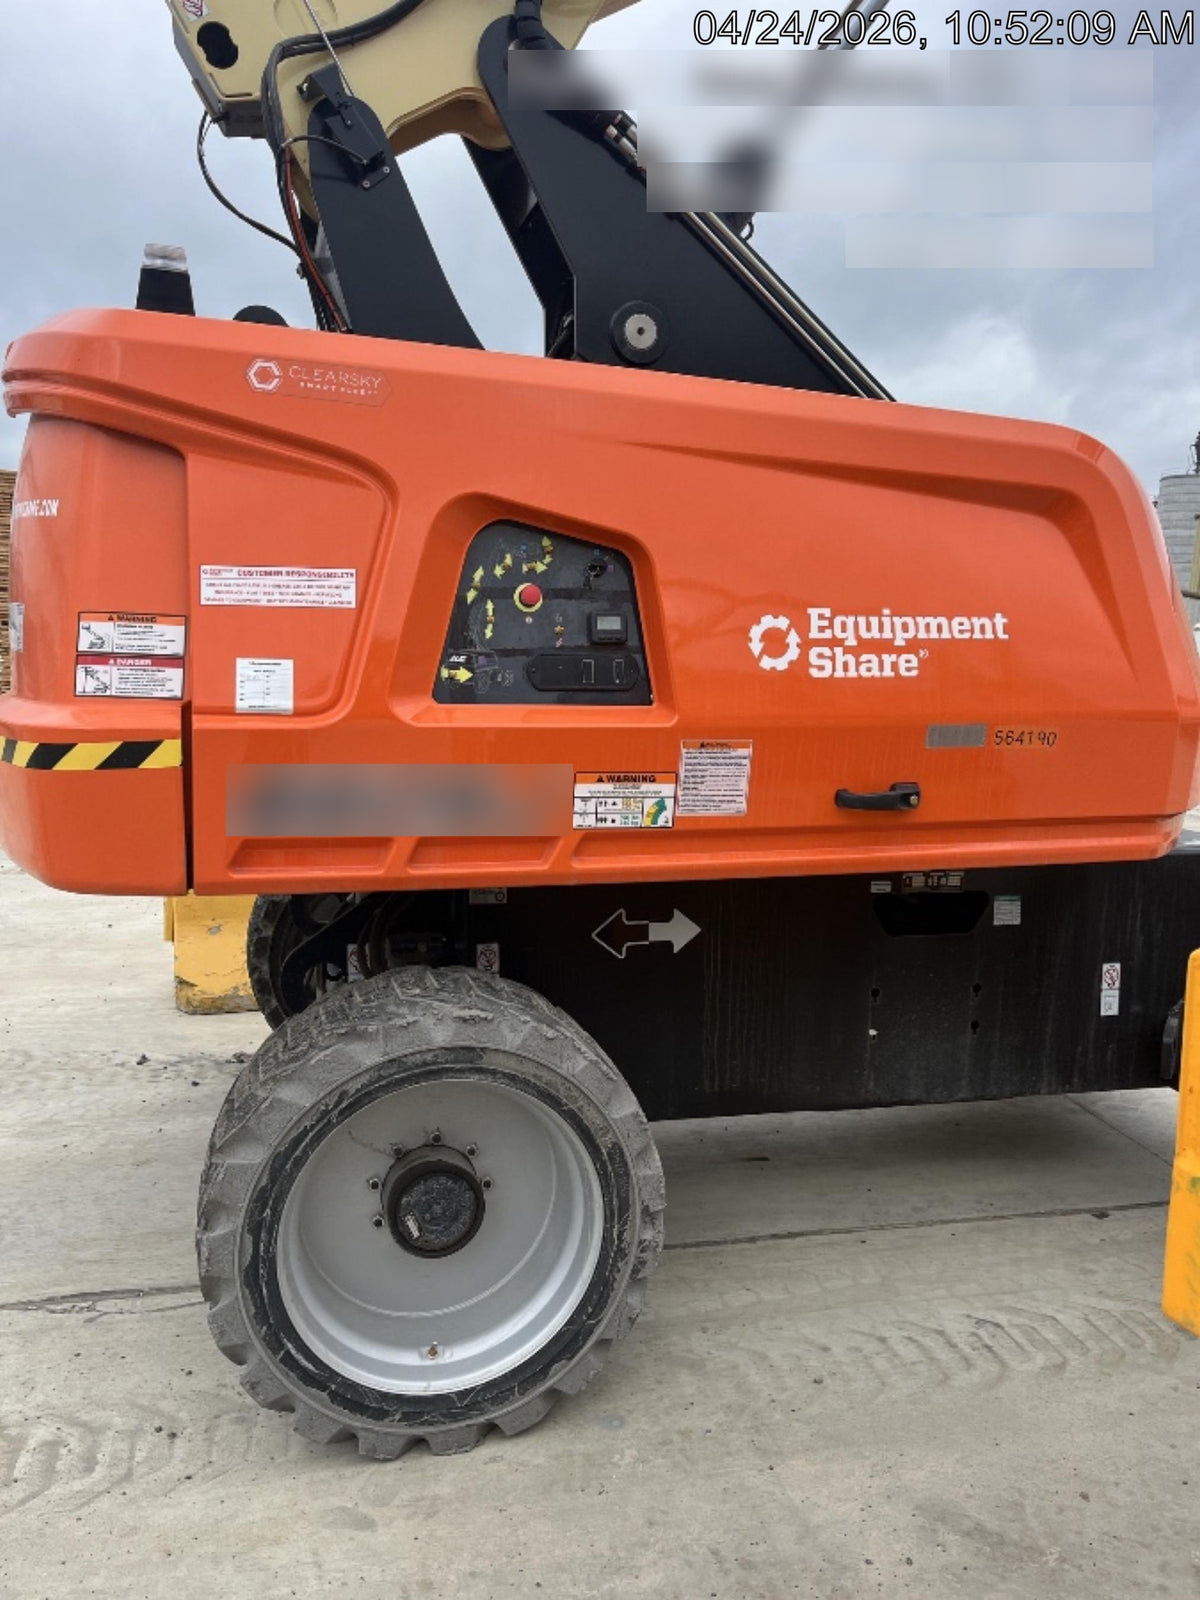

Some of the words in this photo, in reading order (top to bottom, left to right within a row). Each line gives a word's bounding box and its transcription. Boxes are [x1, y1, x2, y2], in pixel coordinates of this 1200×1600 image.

[289, 366, 382, 389] CLEARSKY
[807, 607, 1009, 646] Equipment
[808, 646, 920, 679] Share
[607, 774, 657, 784] WARNING
